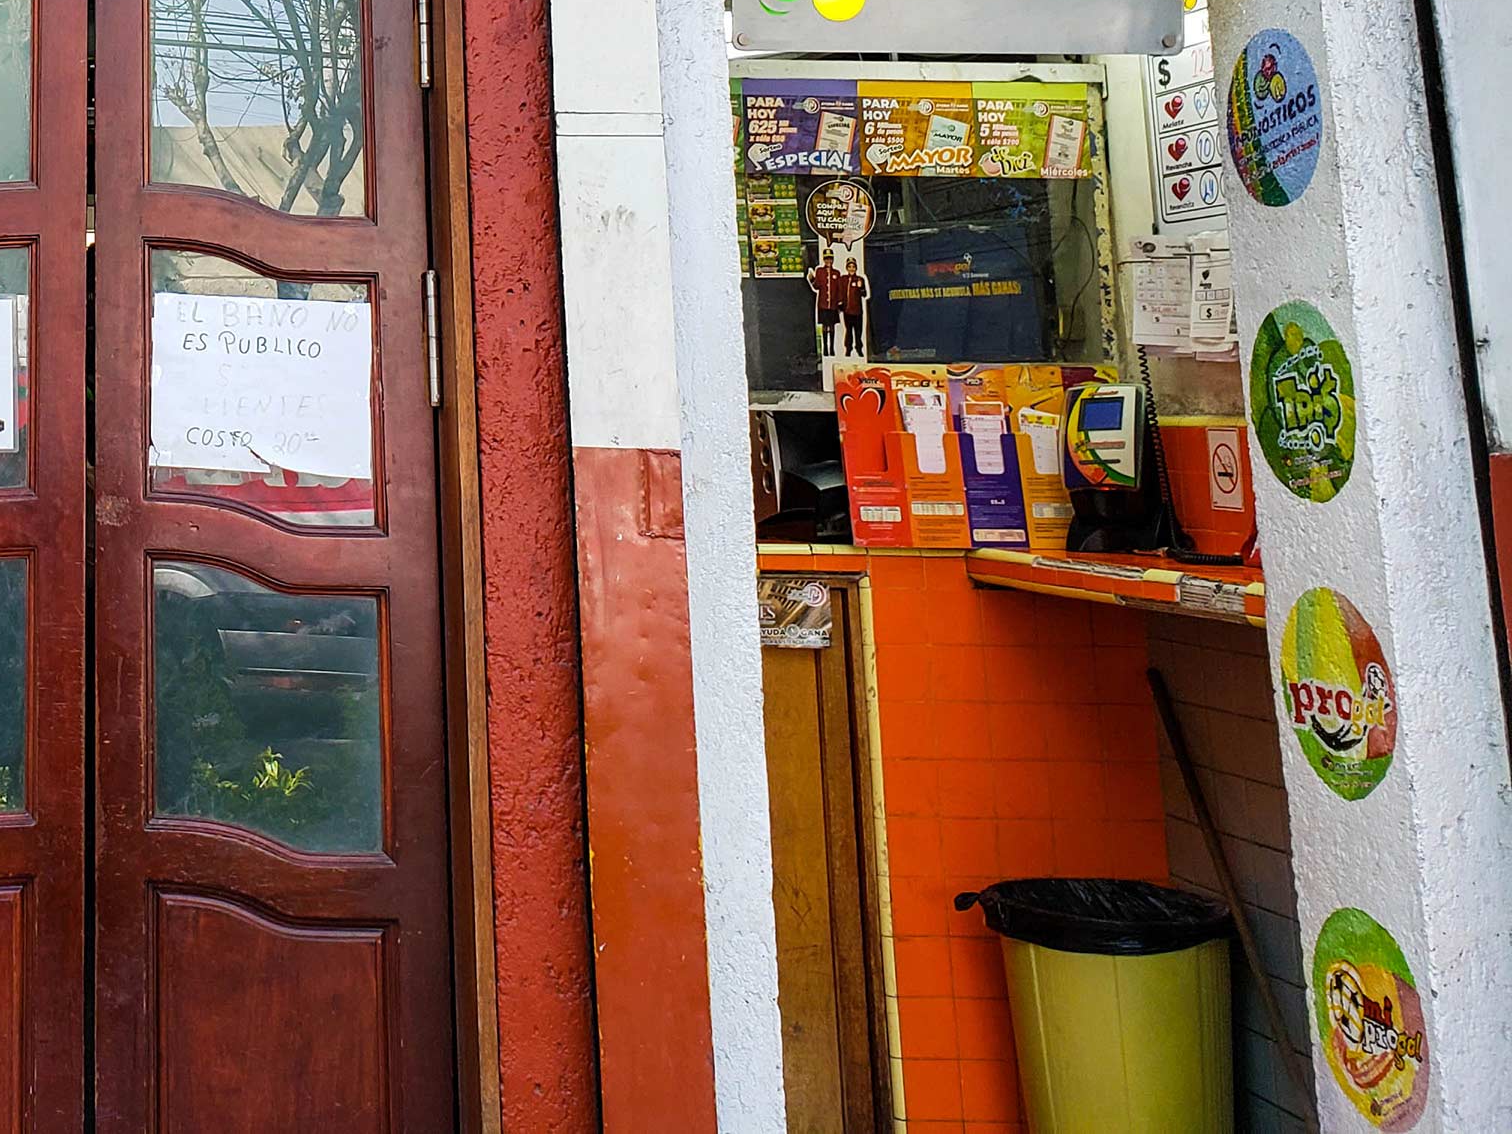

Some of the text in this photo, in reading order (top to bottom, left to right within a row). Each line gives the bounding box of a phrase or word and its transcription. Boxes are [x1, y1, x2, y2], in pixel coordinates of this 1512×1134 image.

[747, 97, 785, 108] PARA
[862, 98, 899, 109] PARA
[977, 100, 1014, 111] PARA
[748, 109, 777, 119] HOY
[863, 111, 891, 120] HOY
[978, 112, 1006, 122] HOY
[749, 120, 778, 134] 625
[864, 122, 875, 136] 6
[980, 124, 990, 137] 5
[933, 132, 963, 142] MAYOR
[765, 150, 853, 172] ESPECIAL
[886, 146, 973, 173] MAYOR
[936, 166, 970, 174] Martes
[1040, 167, 1088, 177] Miércoles
[182, 330, 321, 359] ES PUBLICO
[1288, 680, 1386, 737] progol
[1361, 1017, 1423, 1071] progol
